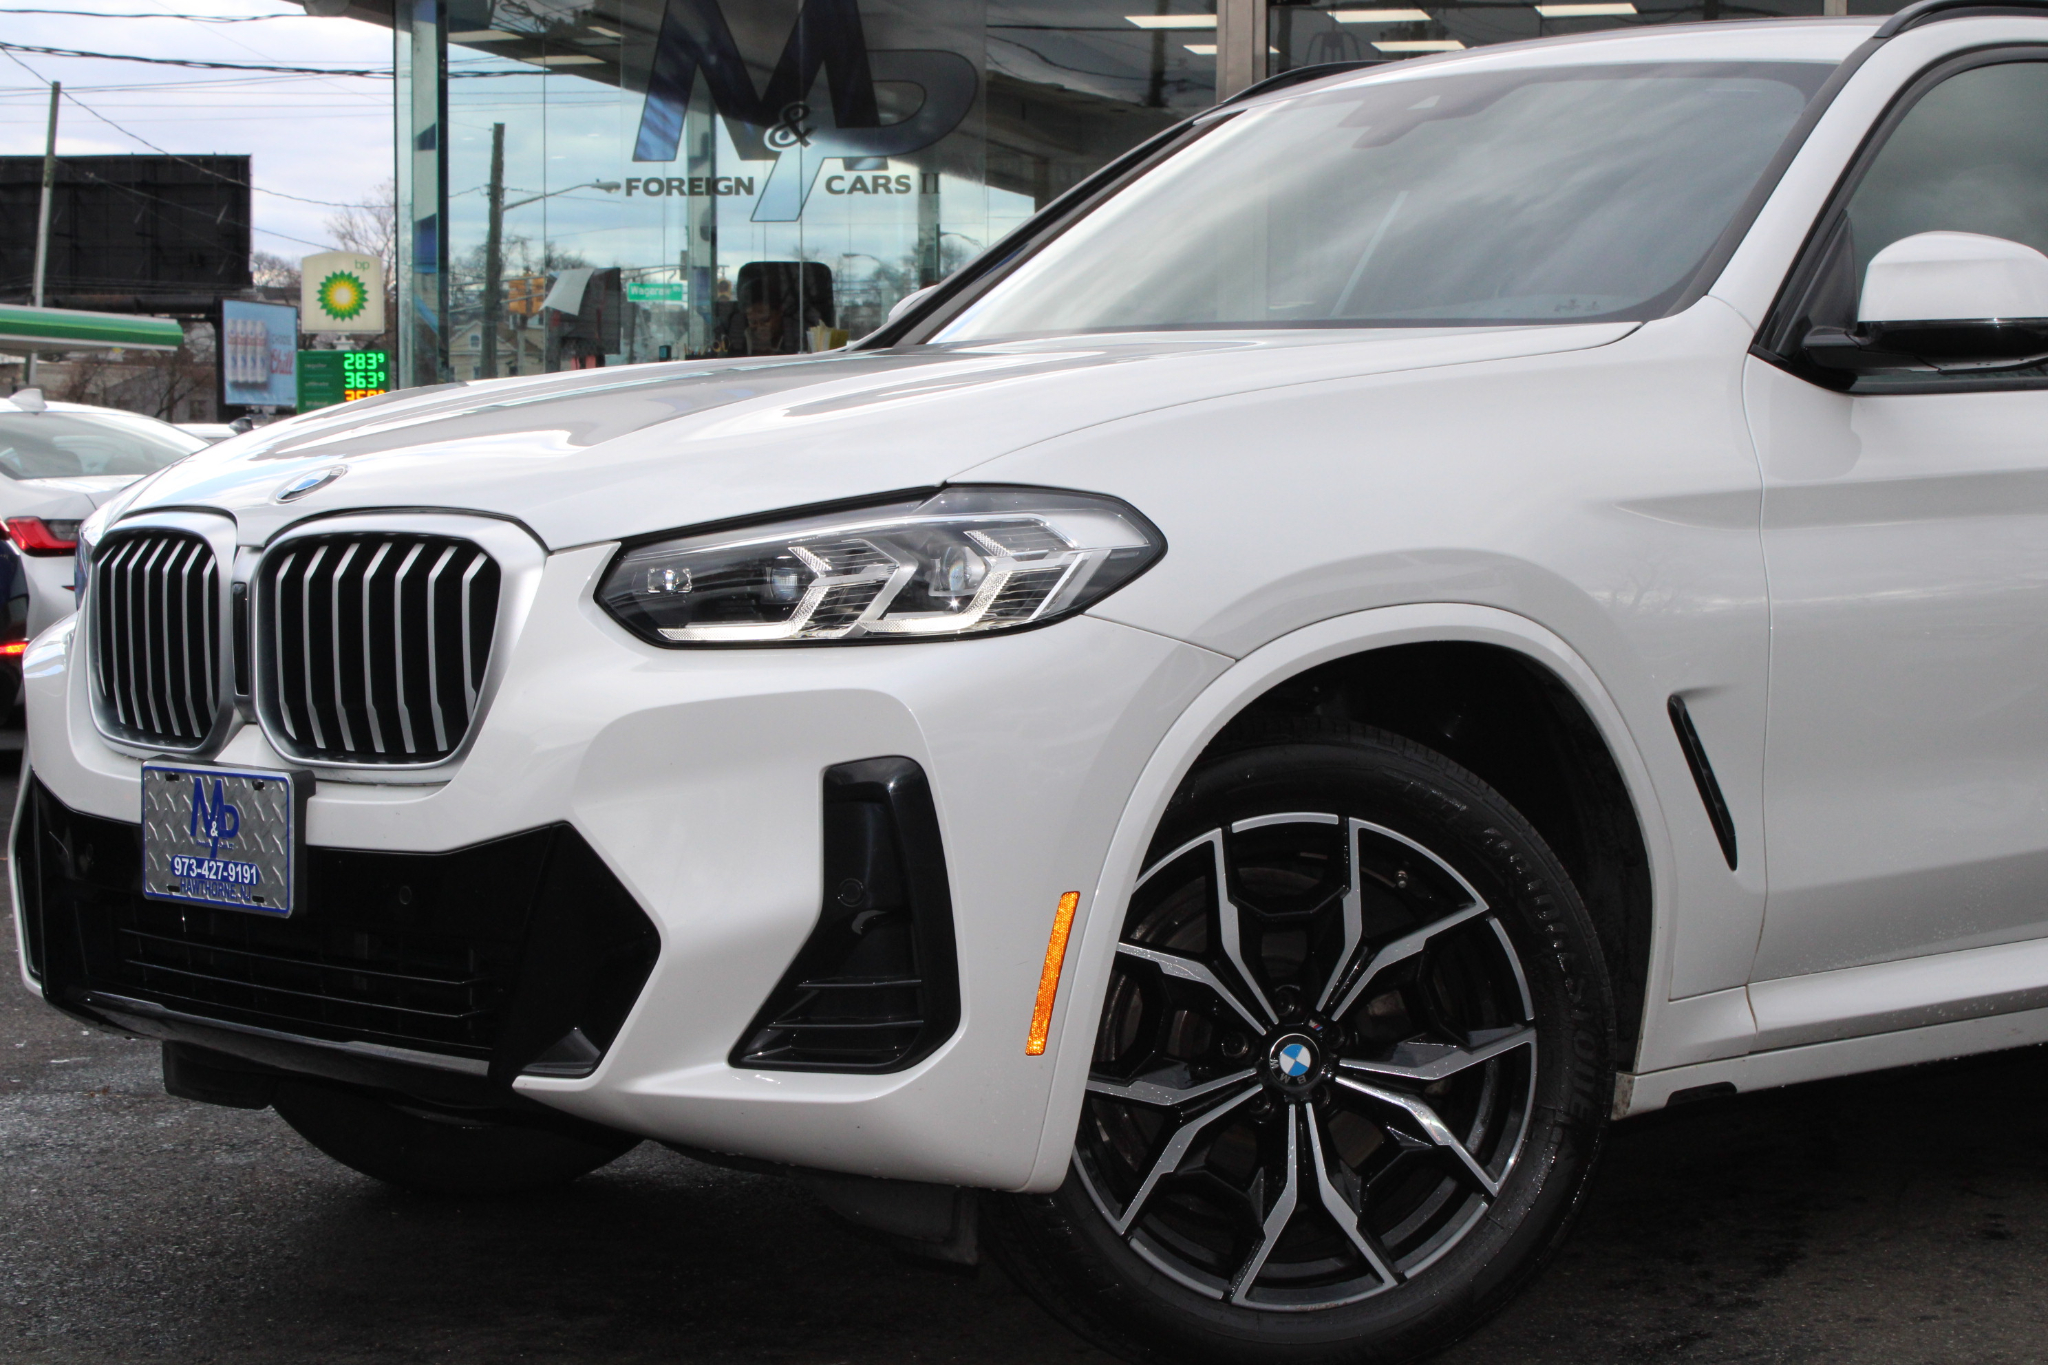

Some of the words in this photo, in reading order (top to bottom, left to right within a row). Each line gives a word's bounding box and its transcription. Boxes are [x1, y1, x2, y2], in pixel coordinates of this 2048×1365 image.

[625, 176, 755, 197] FOREIGN
[825, 174, 912, 195] CARS
[354, 259, 371, 272] bp
[173, 856, 258, 885] 973-427-9191
